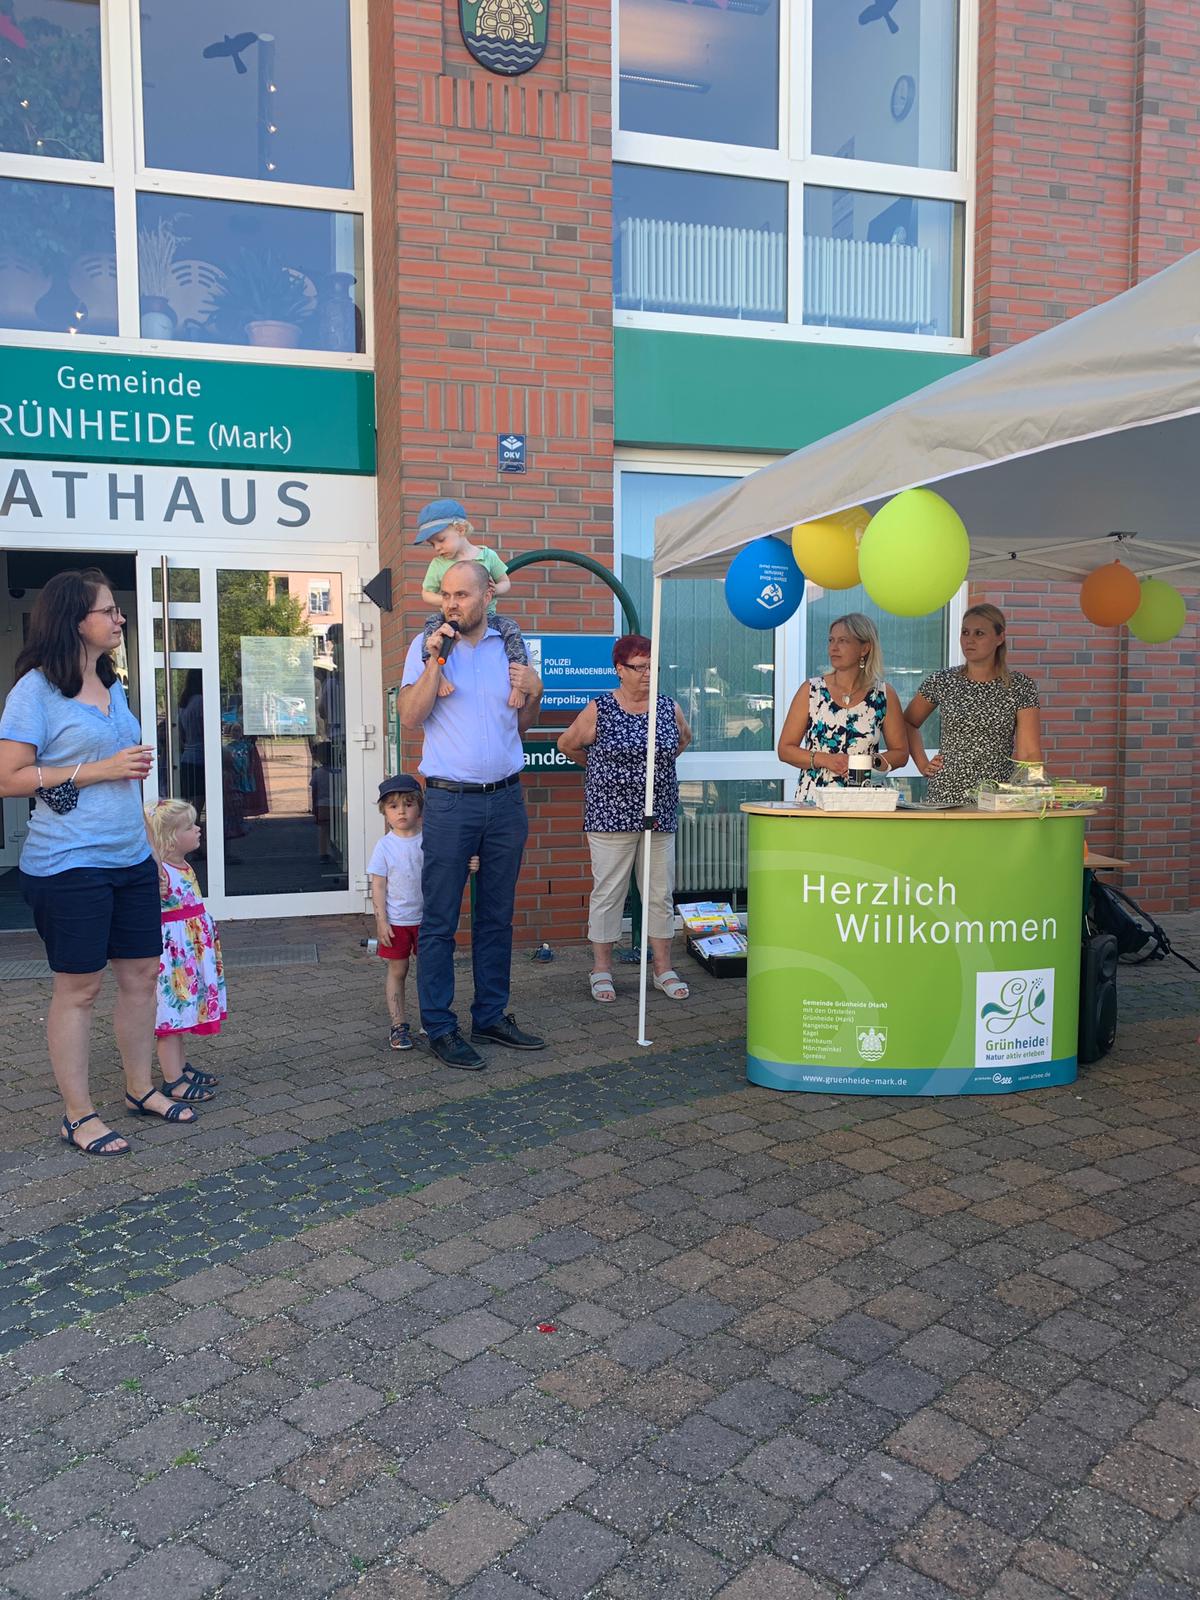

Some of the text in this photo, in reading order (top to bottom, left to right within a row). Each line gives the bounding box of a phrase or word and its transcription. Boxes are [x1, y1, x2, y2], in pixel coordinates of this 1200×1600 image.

[57, 365, 201, 398] Gemeinde
[208, 421, 292, 454] (Mark)
[503, 451, 521, 459] OKV
[544, 658, 571, 666] POLIZEI
[544, 667, 617, 675] LAND BRANDENBURG
[802, 874, 957, 906] Herzlich
[835, 913, 1057, 944] Willkommen
[802, 999, 834, 1007] Gemeinde
[868, 1001, 888, 1009] (Mark)
[985, 1036, 1045, 1051] Grünheide
[1006, 1052, 1022, 1060] aktiv
[1023, 1050, 1045, 1058] erleben
[802, 1075, 907, 1086] www.gruenheide-mark.de
